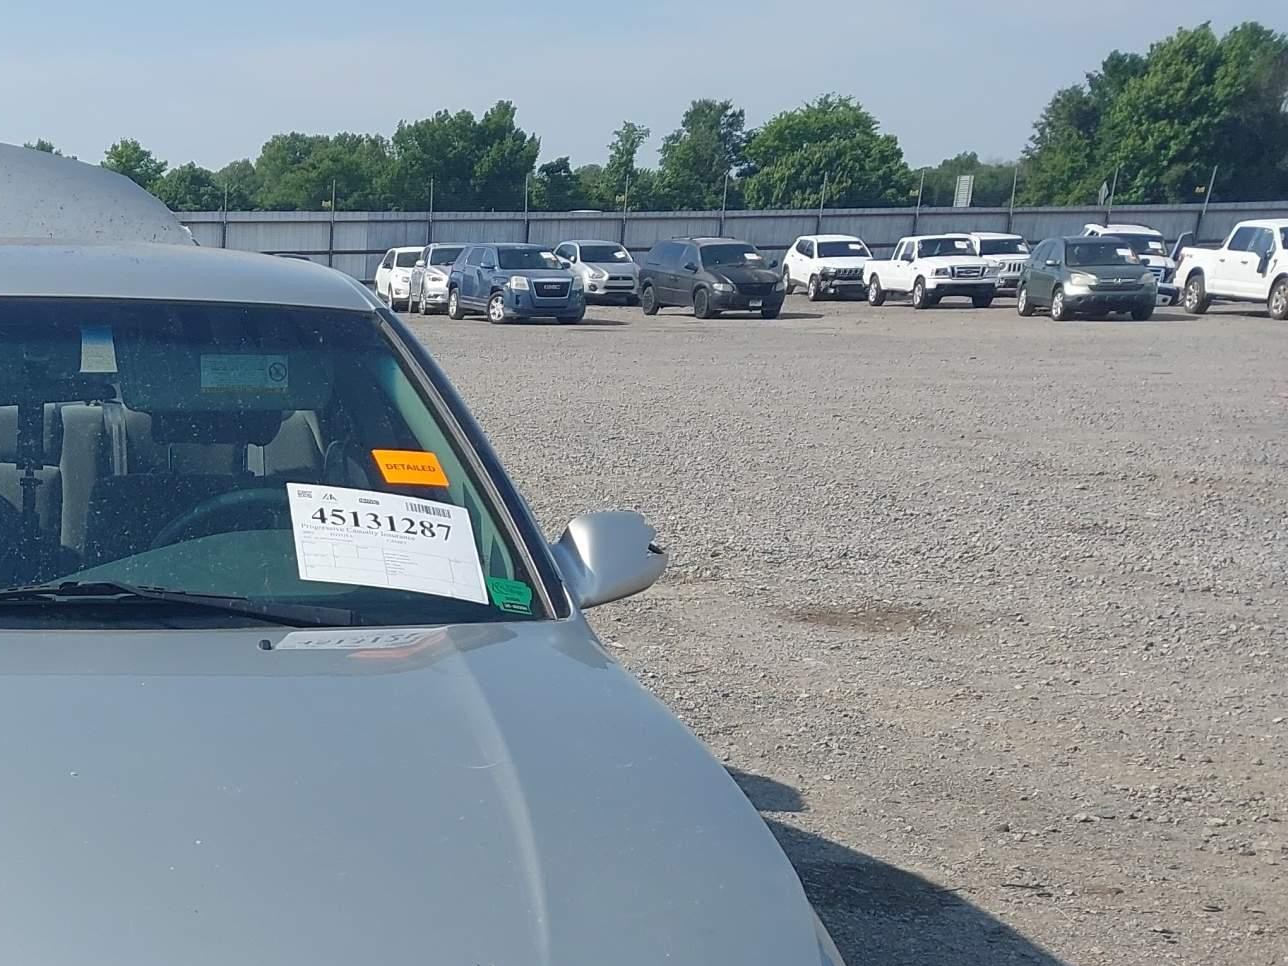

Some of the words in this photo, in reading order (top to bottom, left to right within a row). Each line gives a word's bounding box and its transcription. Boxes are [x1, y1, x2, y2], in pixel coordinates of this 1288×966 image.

[385, 463, 436, 473] DETAILED
[301, 522, 345, 533] Progressive
[346, 526, 379, 537] Casualty
[311, 507, 452, 541] 45131287
